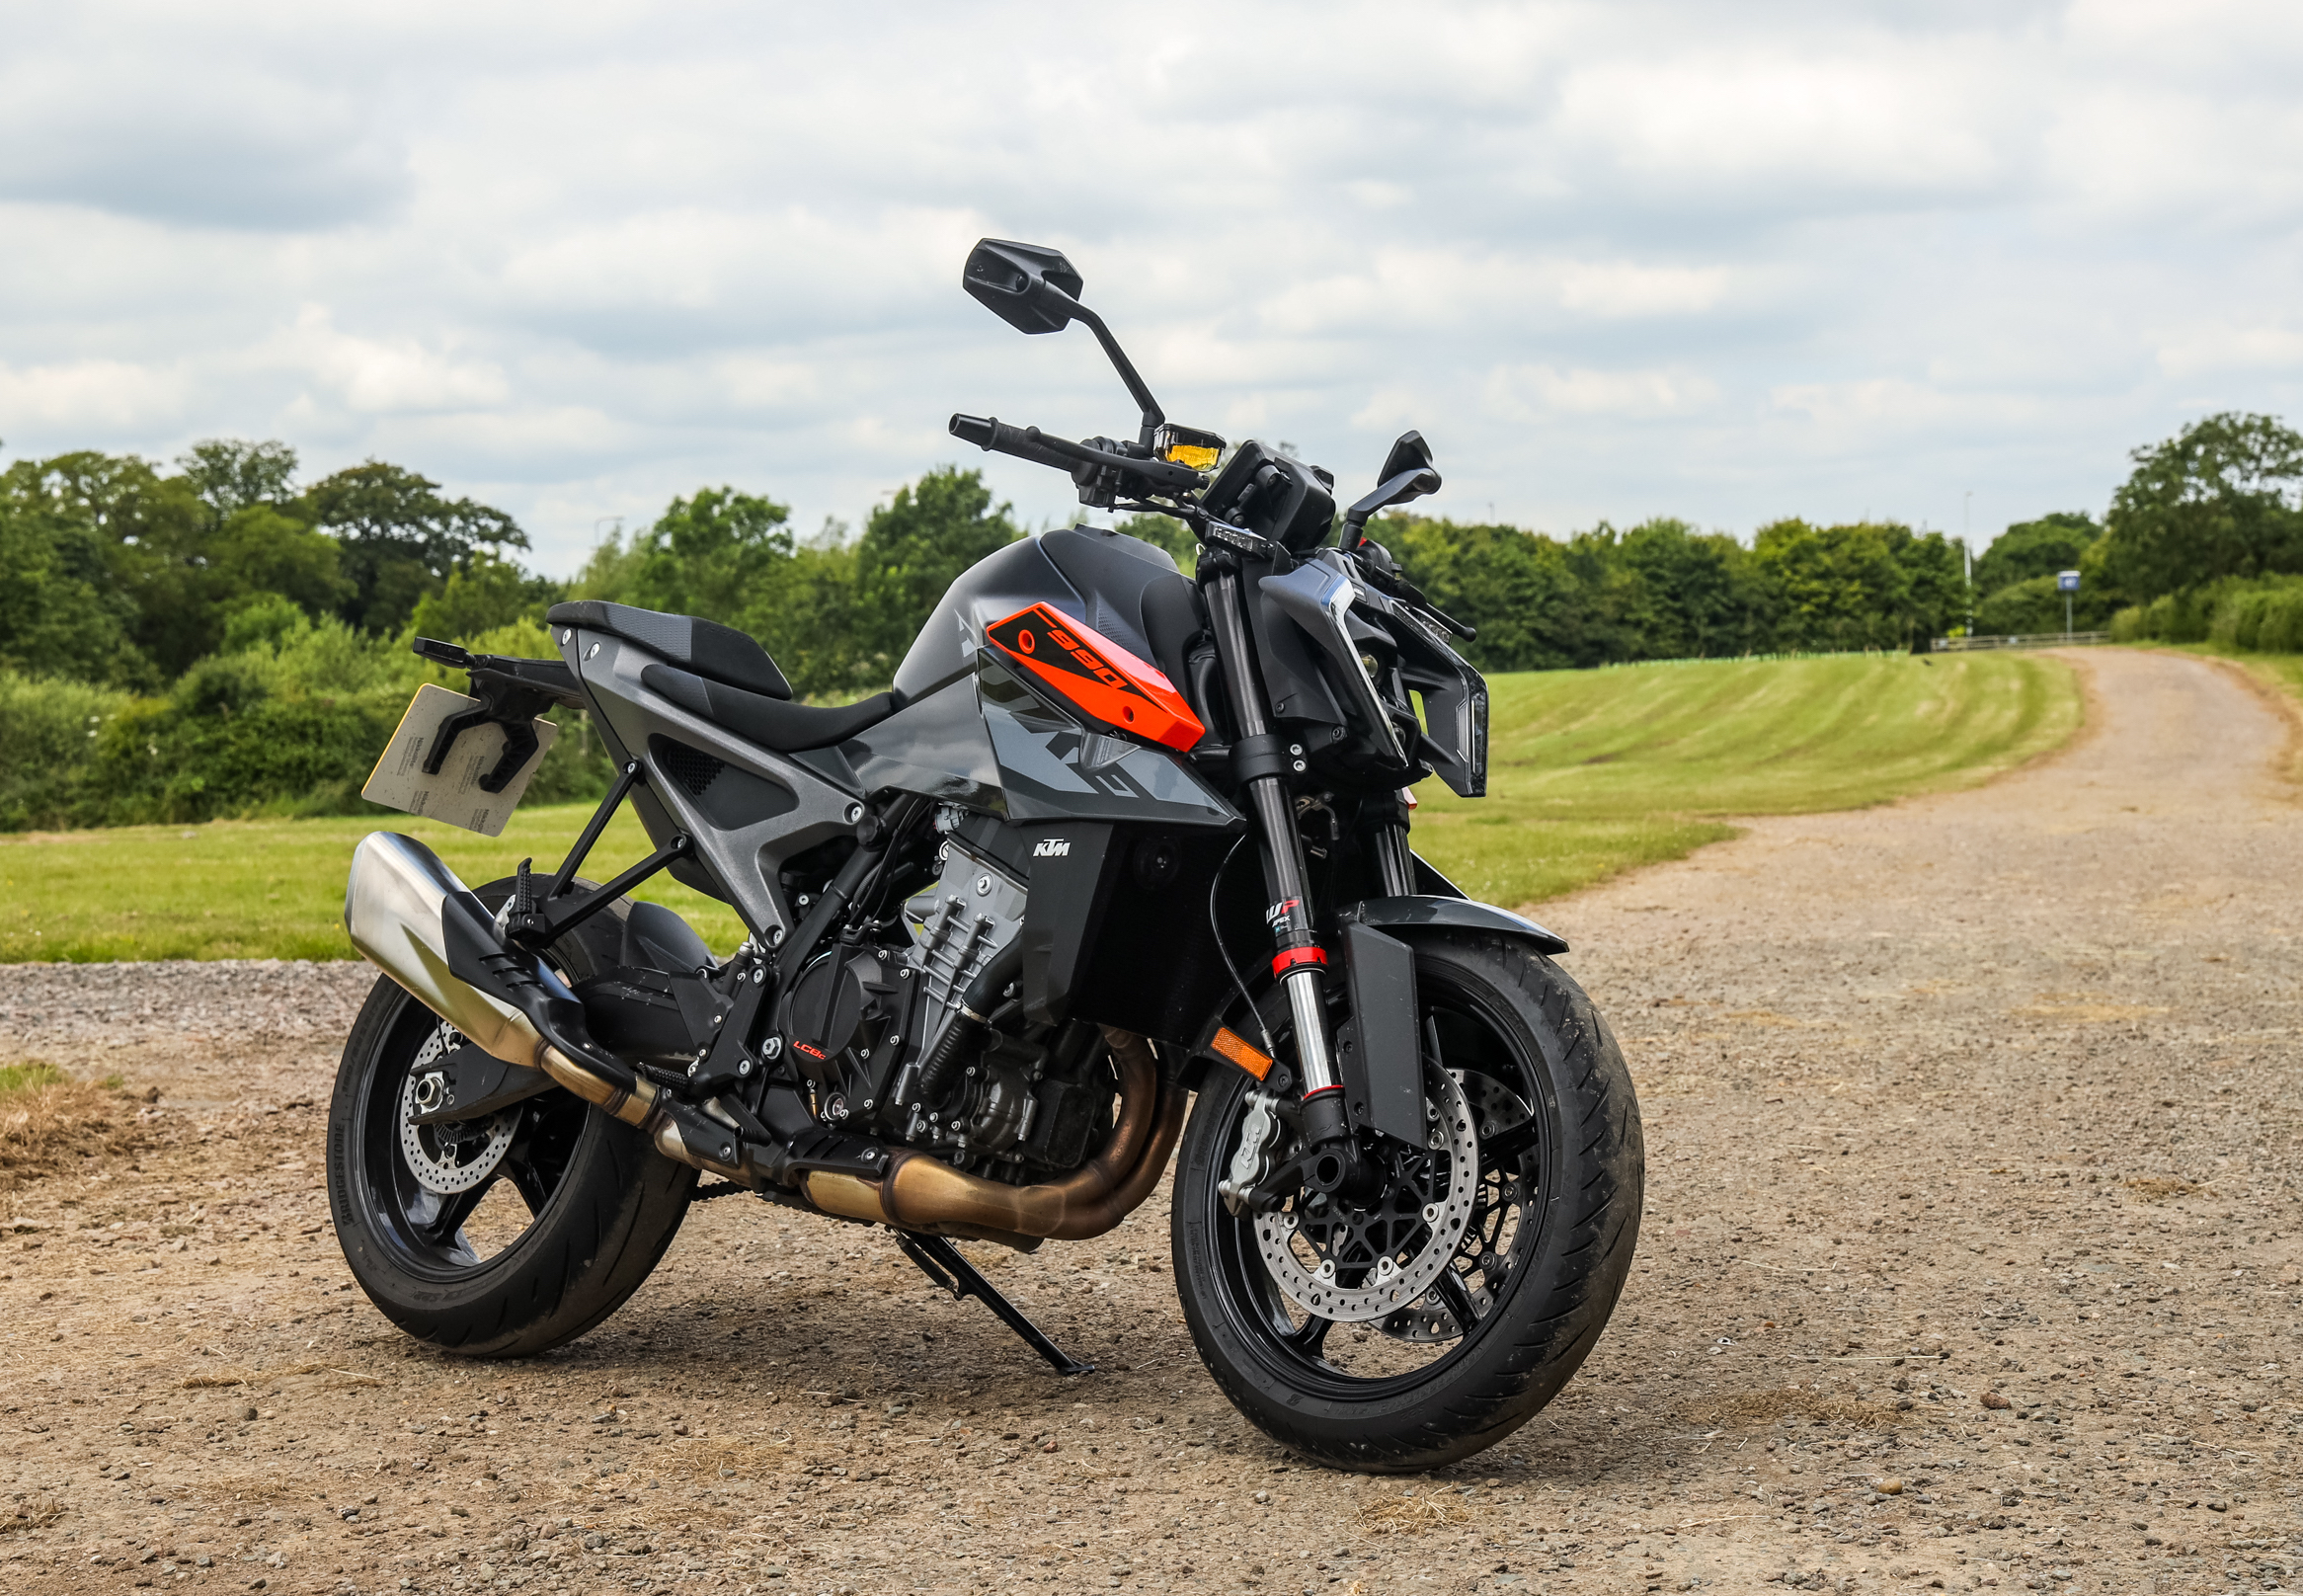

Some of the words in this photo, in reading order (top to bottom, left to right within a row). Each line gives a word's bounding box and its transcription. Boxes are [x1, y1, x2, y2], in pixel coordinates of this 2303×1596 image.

[1047, 629, 1128, 690] 990
[1033, 838, 1071, 856] KTM
[1266, 900, 1300, 924] WP
[334, 1124, 356, 1227] BRIDGESTONE
